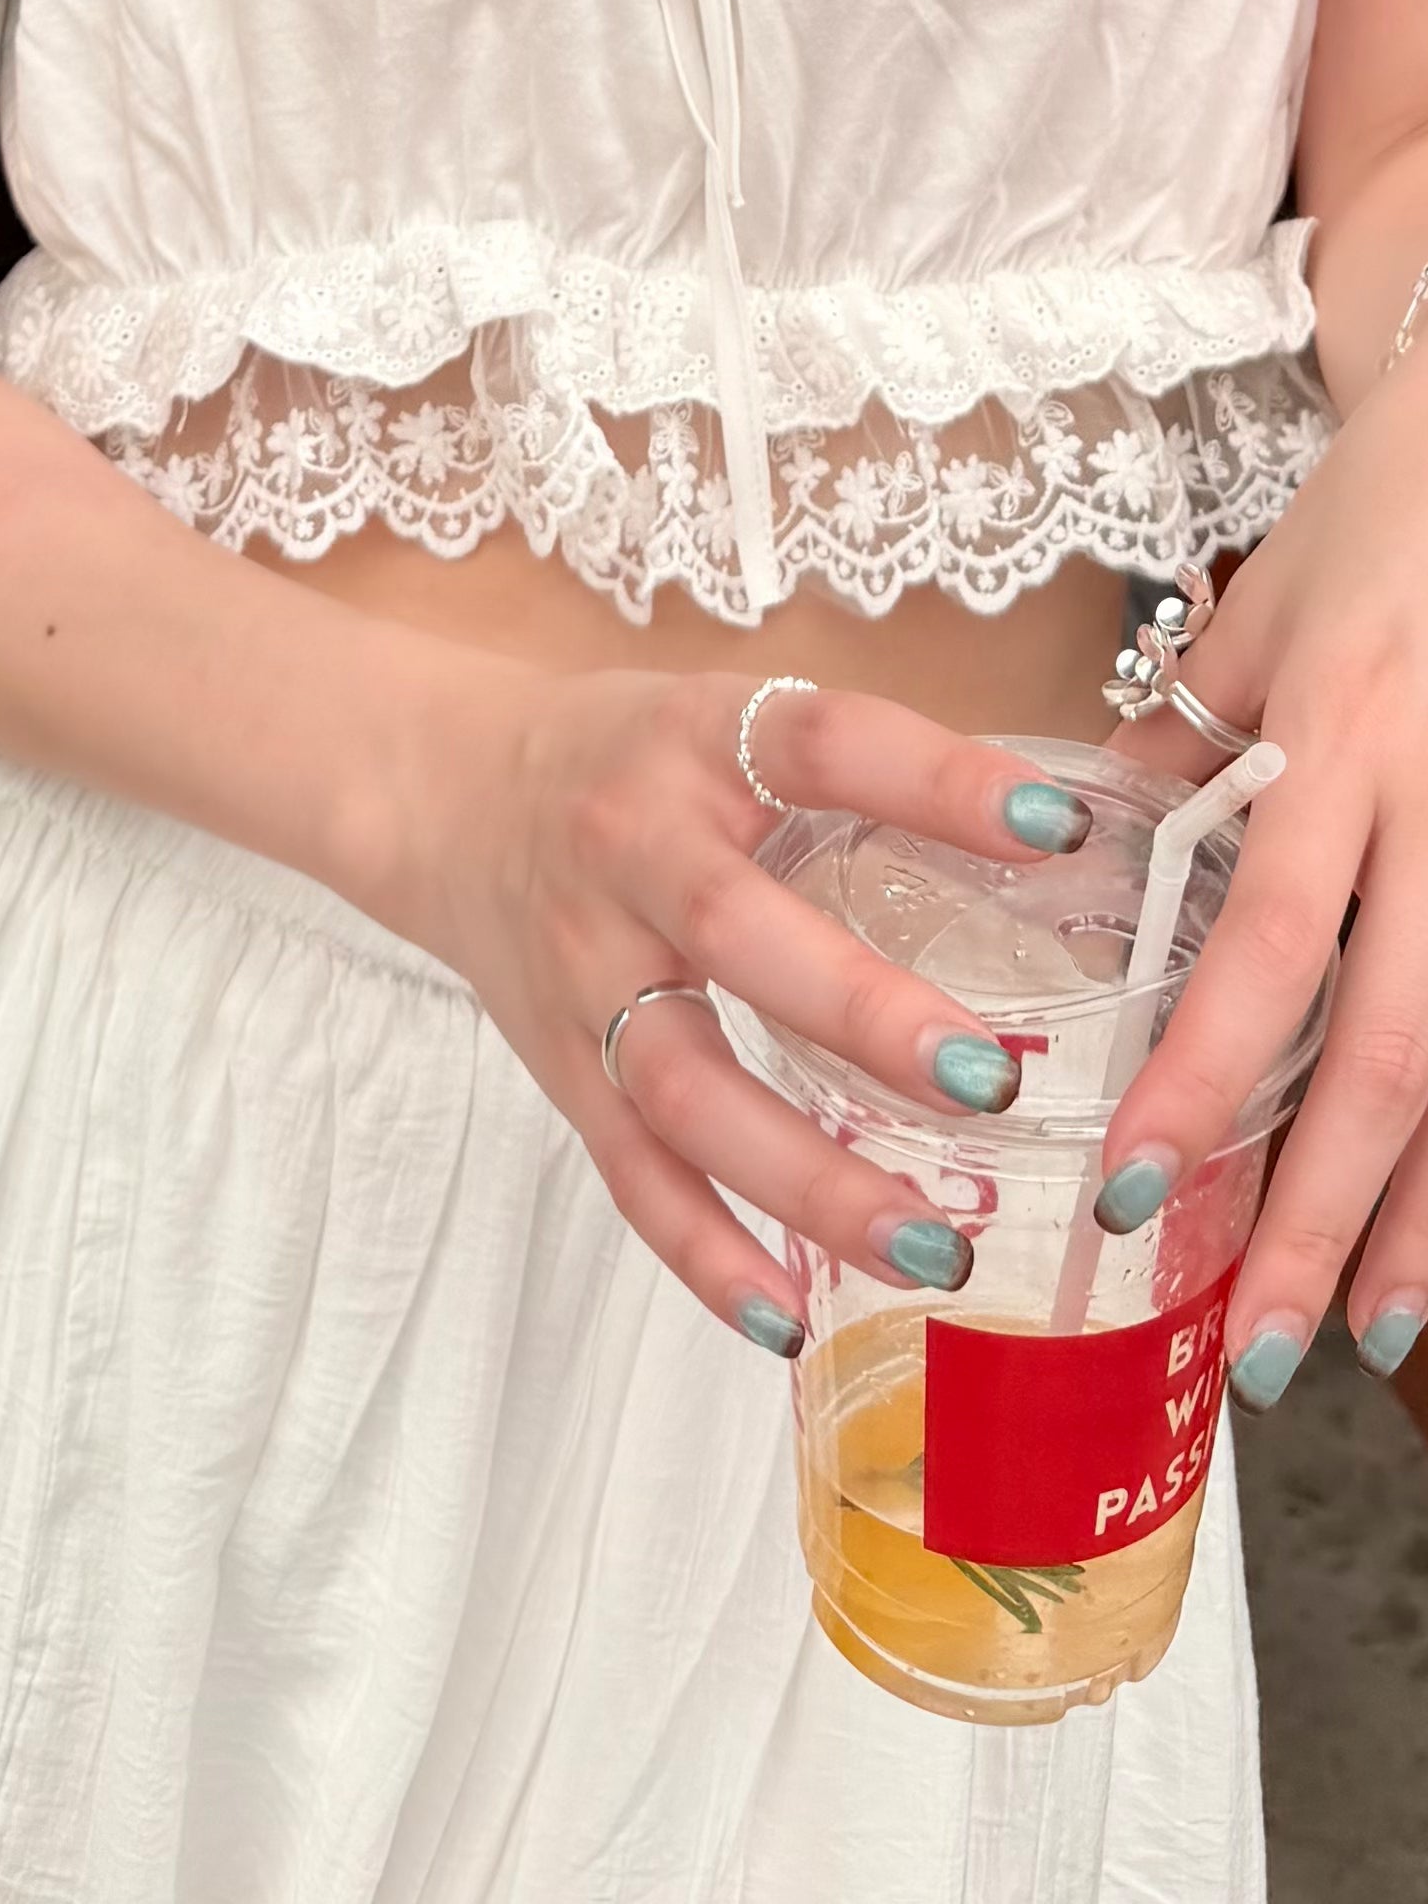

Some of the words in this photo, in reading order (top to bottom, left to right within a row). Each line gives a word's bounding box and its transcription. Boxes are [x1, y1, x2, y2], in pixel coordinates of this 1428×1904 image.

[1166, 1297, 1225, 1378] BR
[1165, 1348, 1226, 1438] WI
[1094, 1416, 1215, 1537] PASSI
